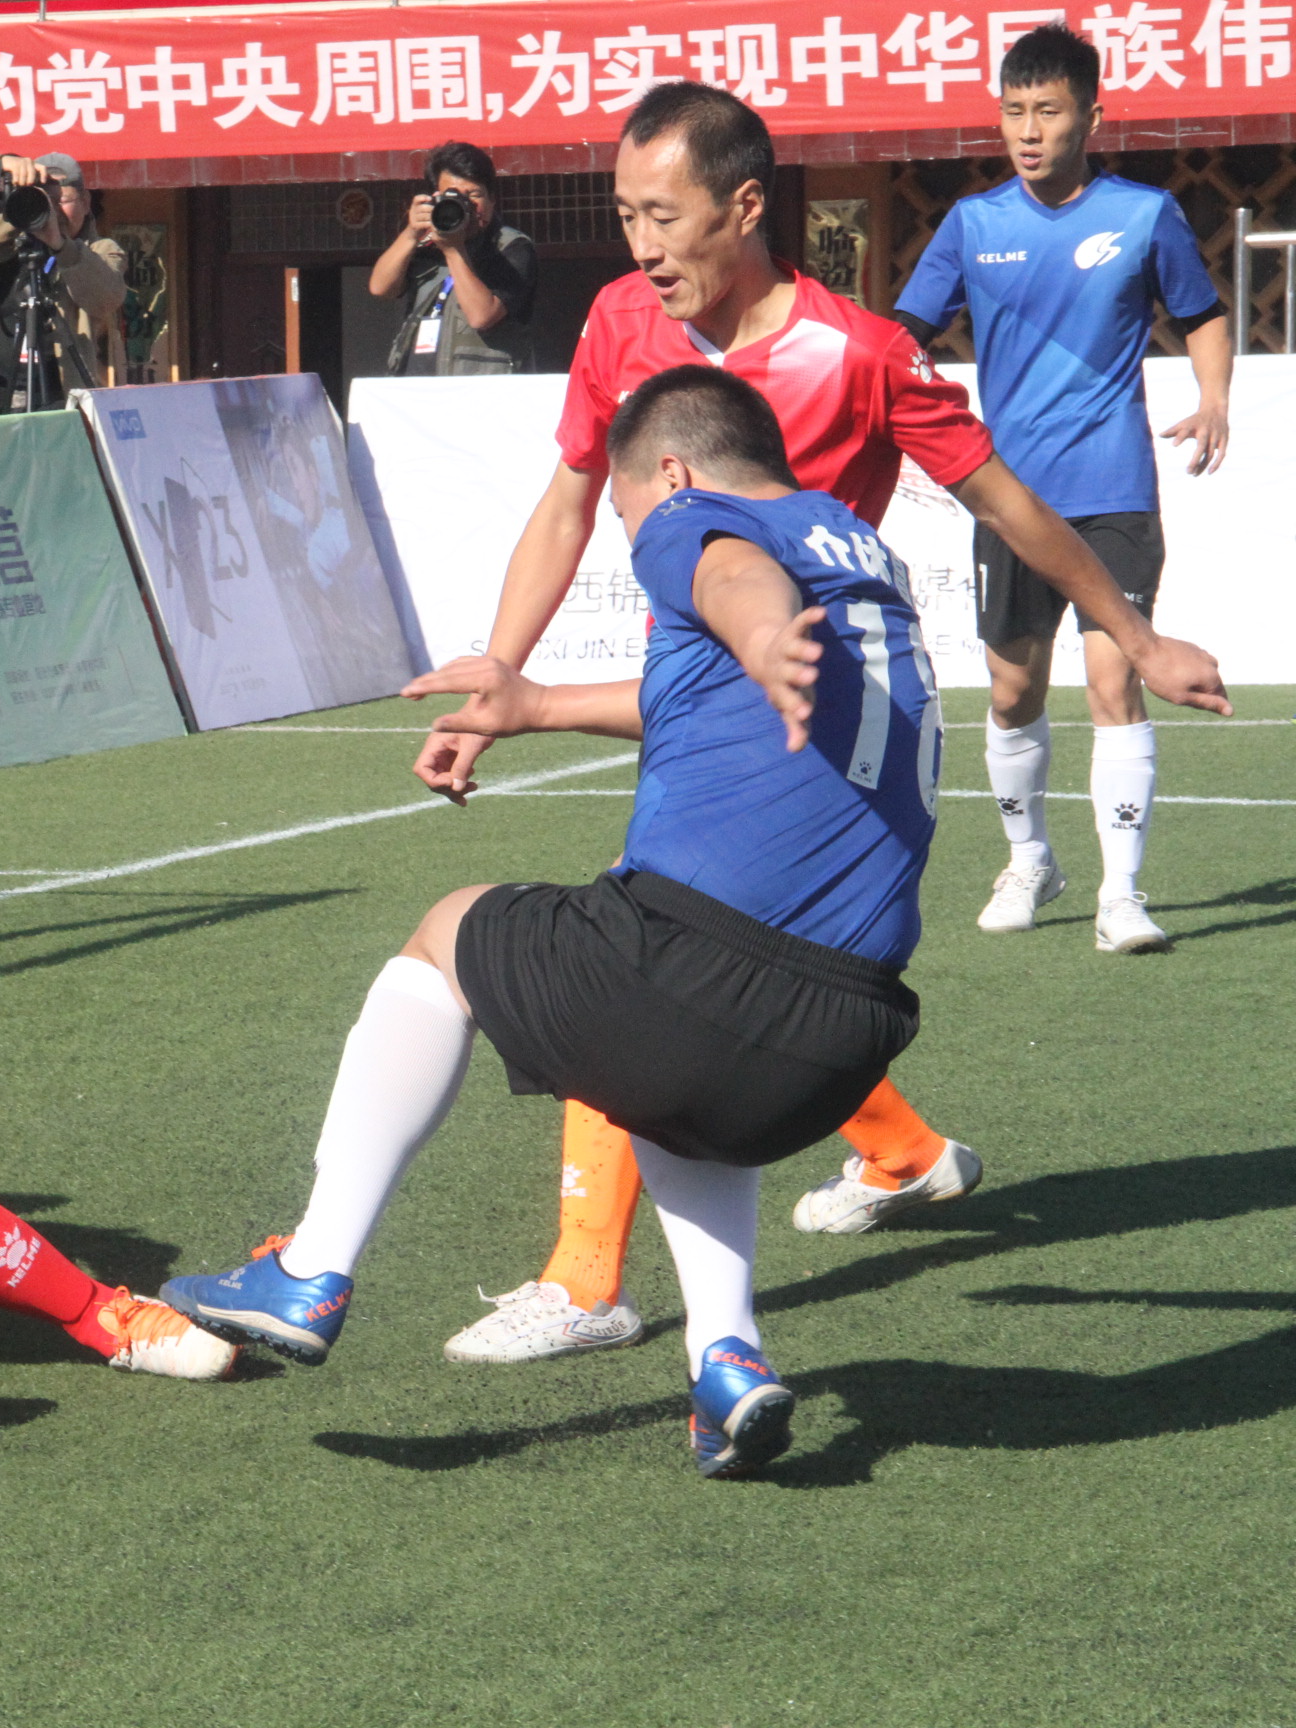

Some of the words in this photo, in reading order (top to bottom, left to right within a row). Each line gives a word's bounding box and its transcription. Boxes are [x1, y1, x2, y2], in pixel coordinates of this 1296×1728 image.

[976, 251, 1028, 264] KELME
[576, 637, 616, 660] JIN
[1111, 822, 1143, 831] KELME
[6, 1236, 42, 1288] KELME
[710, 1350, 769, 1377] KELME
